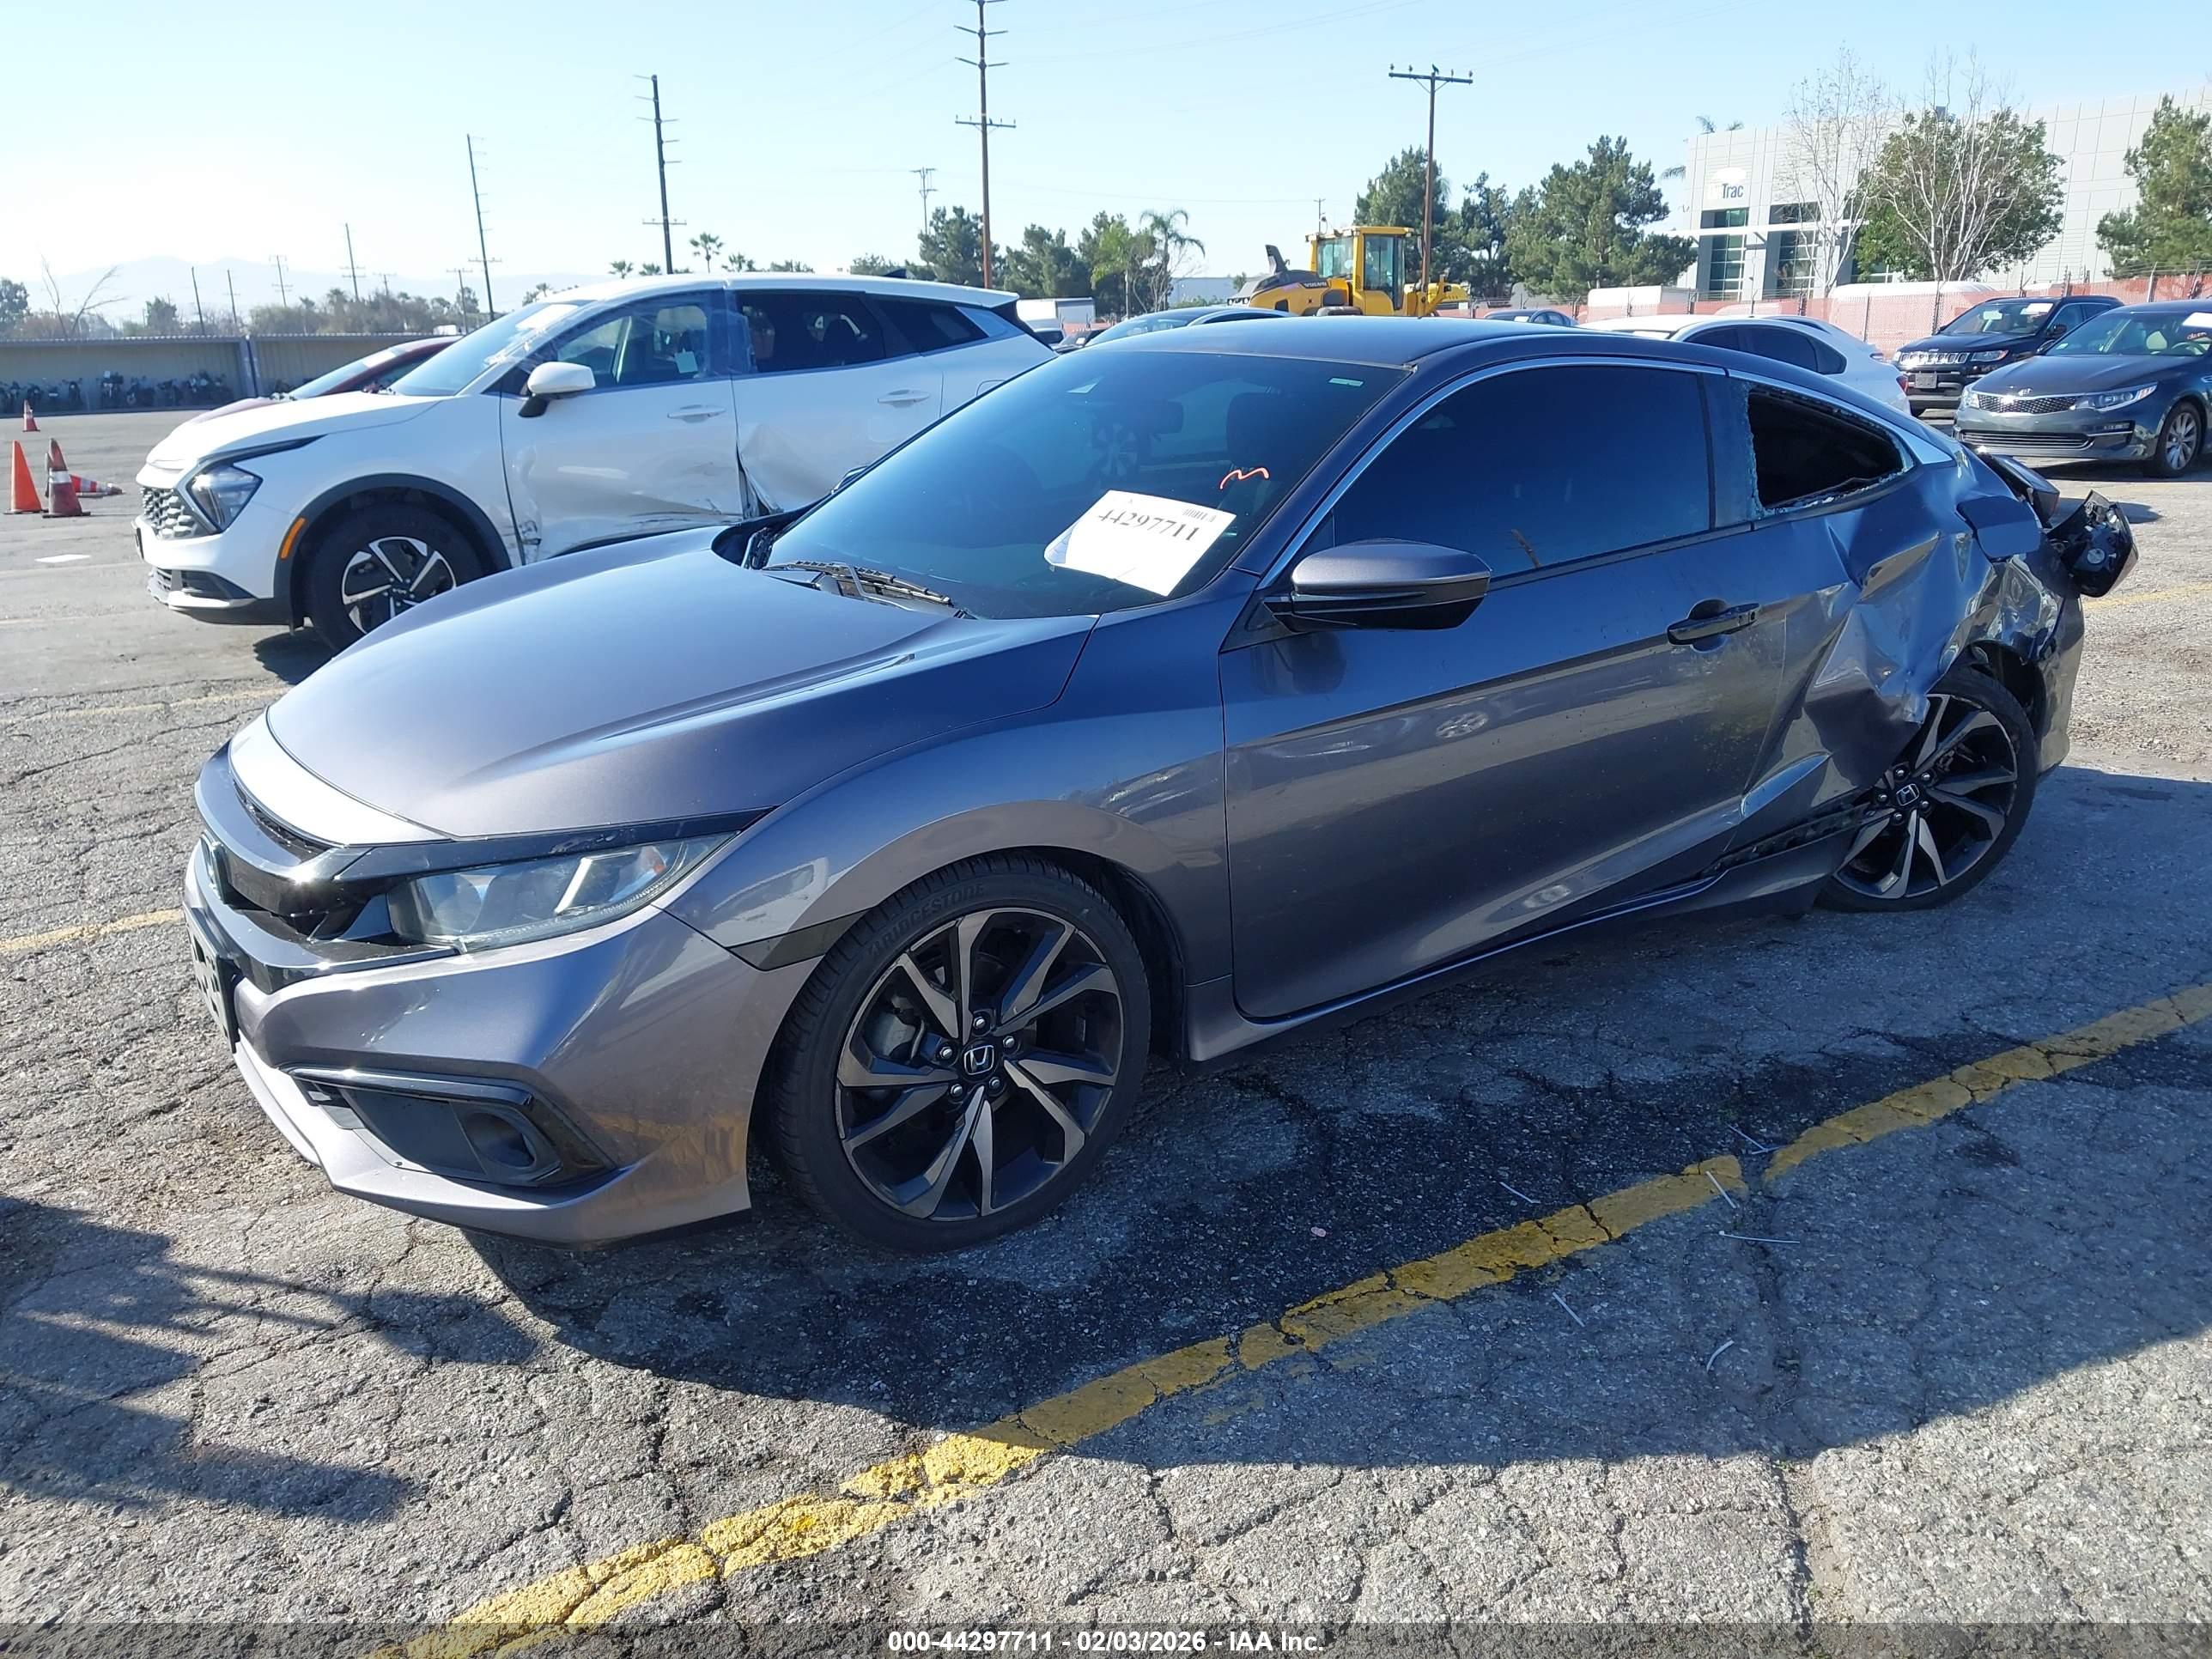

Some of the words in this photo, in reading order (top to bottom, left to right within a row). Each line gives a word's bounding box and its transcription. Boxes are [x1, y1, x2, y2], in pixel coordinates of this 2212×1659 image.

[1722, 183, 1744, 198] Trac
[1097, 508, 1200, 541] 44297711
[866, 884, 985, 957] BRIDGESTONE
